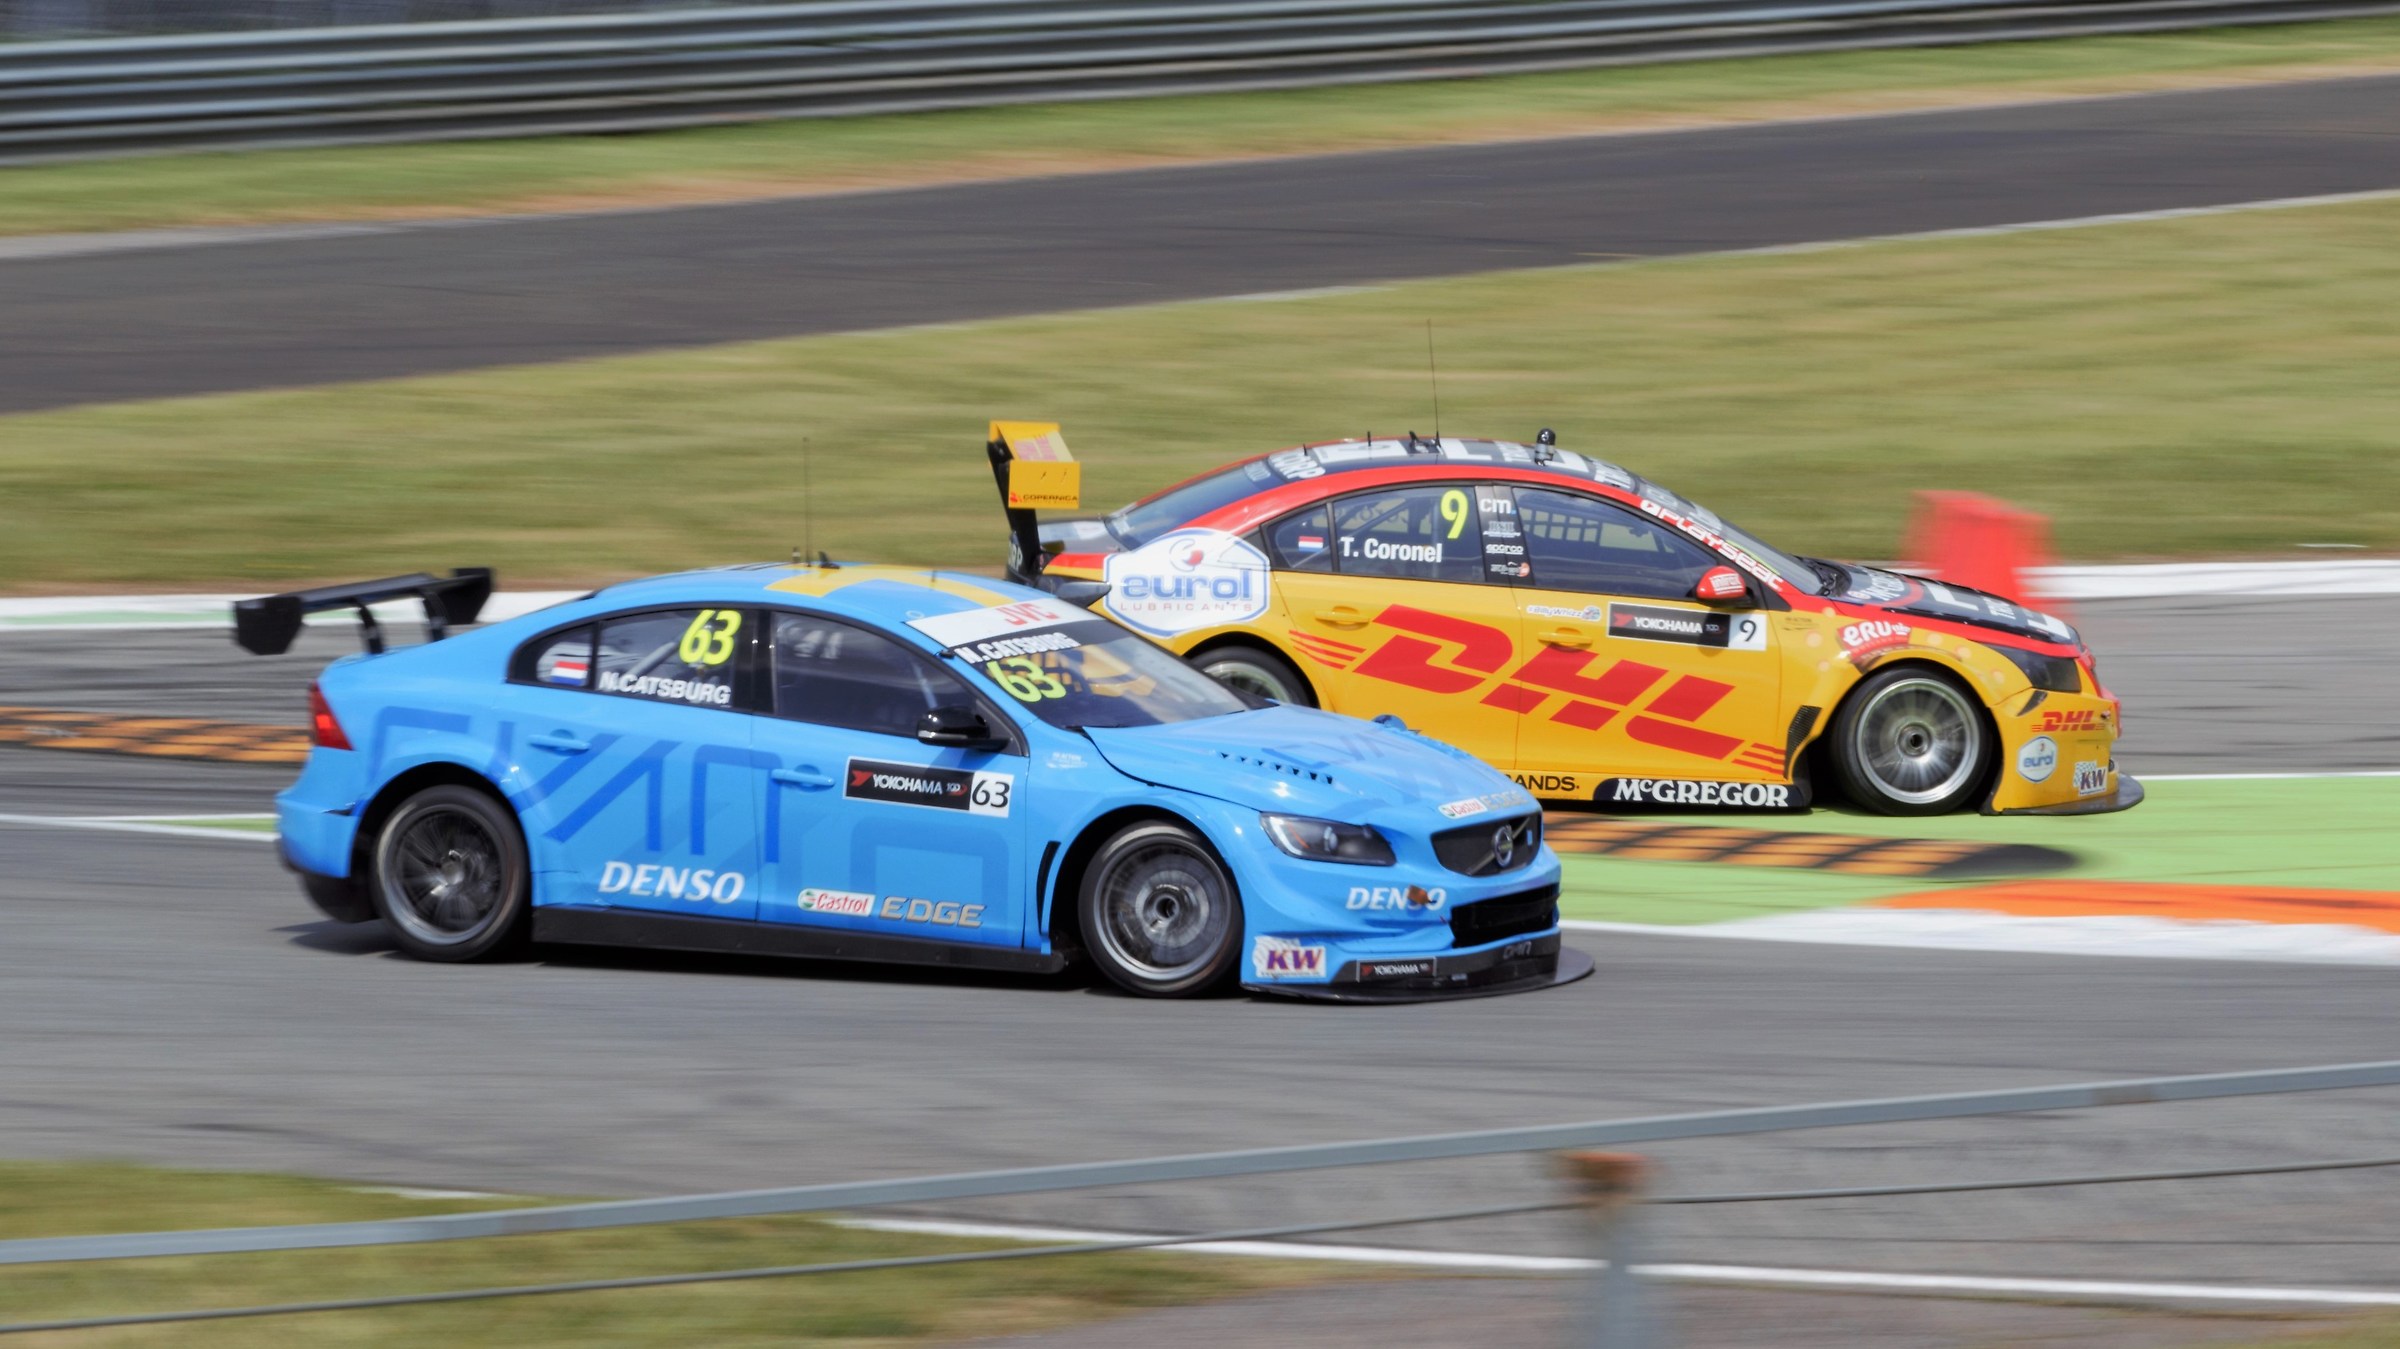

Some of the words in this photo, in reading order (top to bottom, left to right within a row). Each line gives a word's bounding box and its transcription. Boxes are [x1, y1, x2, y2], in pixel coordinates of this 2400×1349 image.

[1441, 490, 1468, 539] 9
[1340, 536, 1359, 557] T.
[1363, 538, 1443, 563] Coronel
[1121, 568, 1253, 600] eurol
[995, 602, 1060, 626] JVC
[1120, 602, 1253, 612] LUBRICANTS
[679, 609, 742, 665] 63
[1634, 616, 1703, 634] YOKOHAMA
[1739, 619, 1757, 643] 9
[986, 657, 1067, 703] 63
[1352, 603, 1746, 761] DHL
[2042, 710, 2097, 732] DHL
[2023, 752, 2054, 768] eurol
[872, 773, 943, 795] YOKOHAMA
[1612, 778, 1790, 807] McGREGOR
[2080, 768, 2107, 790] KW
[971, 779, 1011, 808] 63
[597, 860, 746, 904] DENSO
[816, 892, 870, 914] Castrol
[878, 895, 988, 929] EDGE
[1266, 948, 1323, 971] KW
